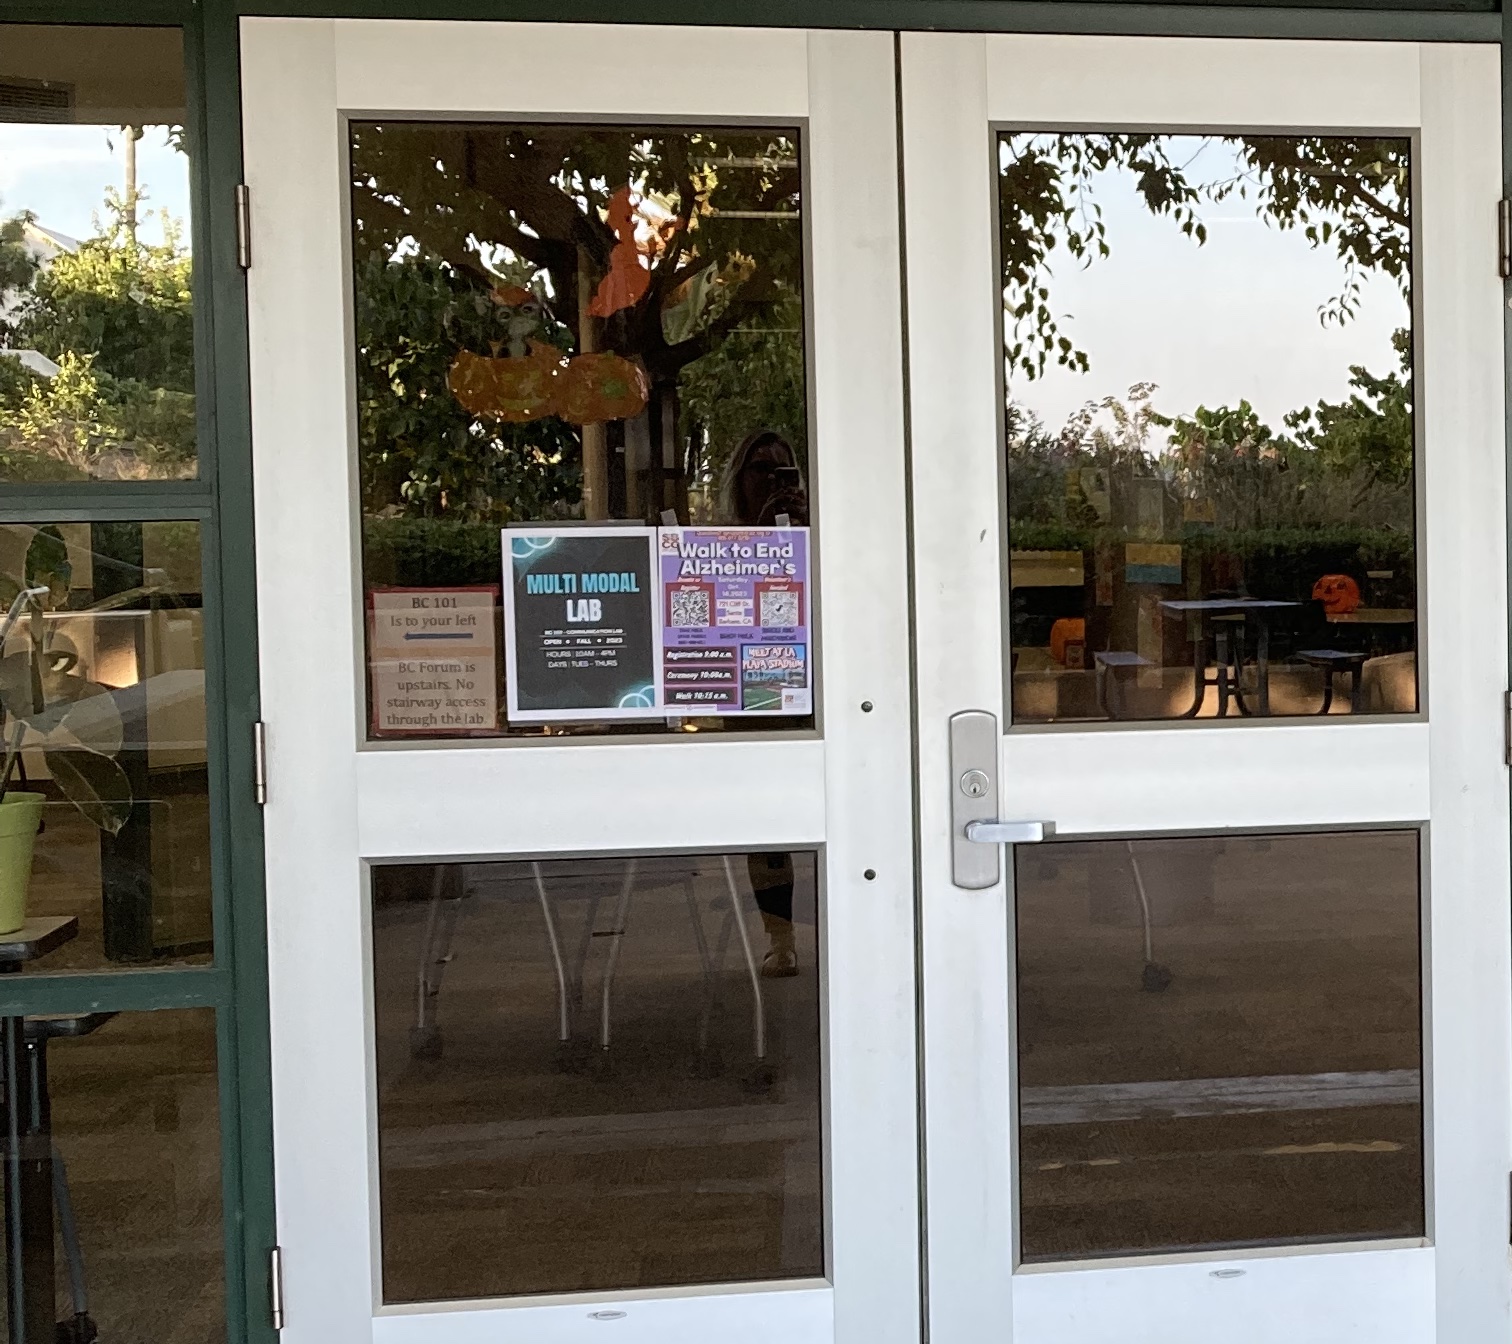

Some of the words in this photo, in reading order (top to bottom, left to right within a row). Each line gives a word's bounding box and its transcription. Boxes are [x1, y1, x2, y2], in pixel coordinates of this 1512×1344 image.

[680, 542, 729, 558] Walk
[731, 543, 752, 558] to
[756, 542, 793, 558] End
[681, 559, 796, 575] Alzheimer's
[527, 573, 577, 595] MULTI
[582, 572, 640, 594] MODAL
[412, 597, 430, 609] BC
[434, 597, 458, 609] 101
[566, 599, 602, 622] LAB
[390, 616, 402, 627] Is
[405, 617, 419, 627] to
[422, 617, 452, 629] your
[455, 614, 477, 627] left
[546, 650, 572, 658] HOURS
[398, 662, 416, 673] BC
[419, 662, 462, 673] Forum
[465, 662, 476, 673] is
[547, 660, 568, 668] DAYS
[397, 679, 453, 693] upstairs.
[456, 679, 475, 690] No
[387, 697, 442, 710] stairway
[445, 699, 487, 707] access
[387, 712, 437, 727] through
[441, 712, 461, 725] the
